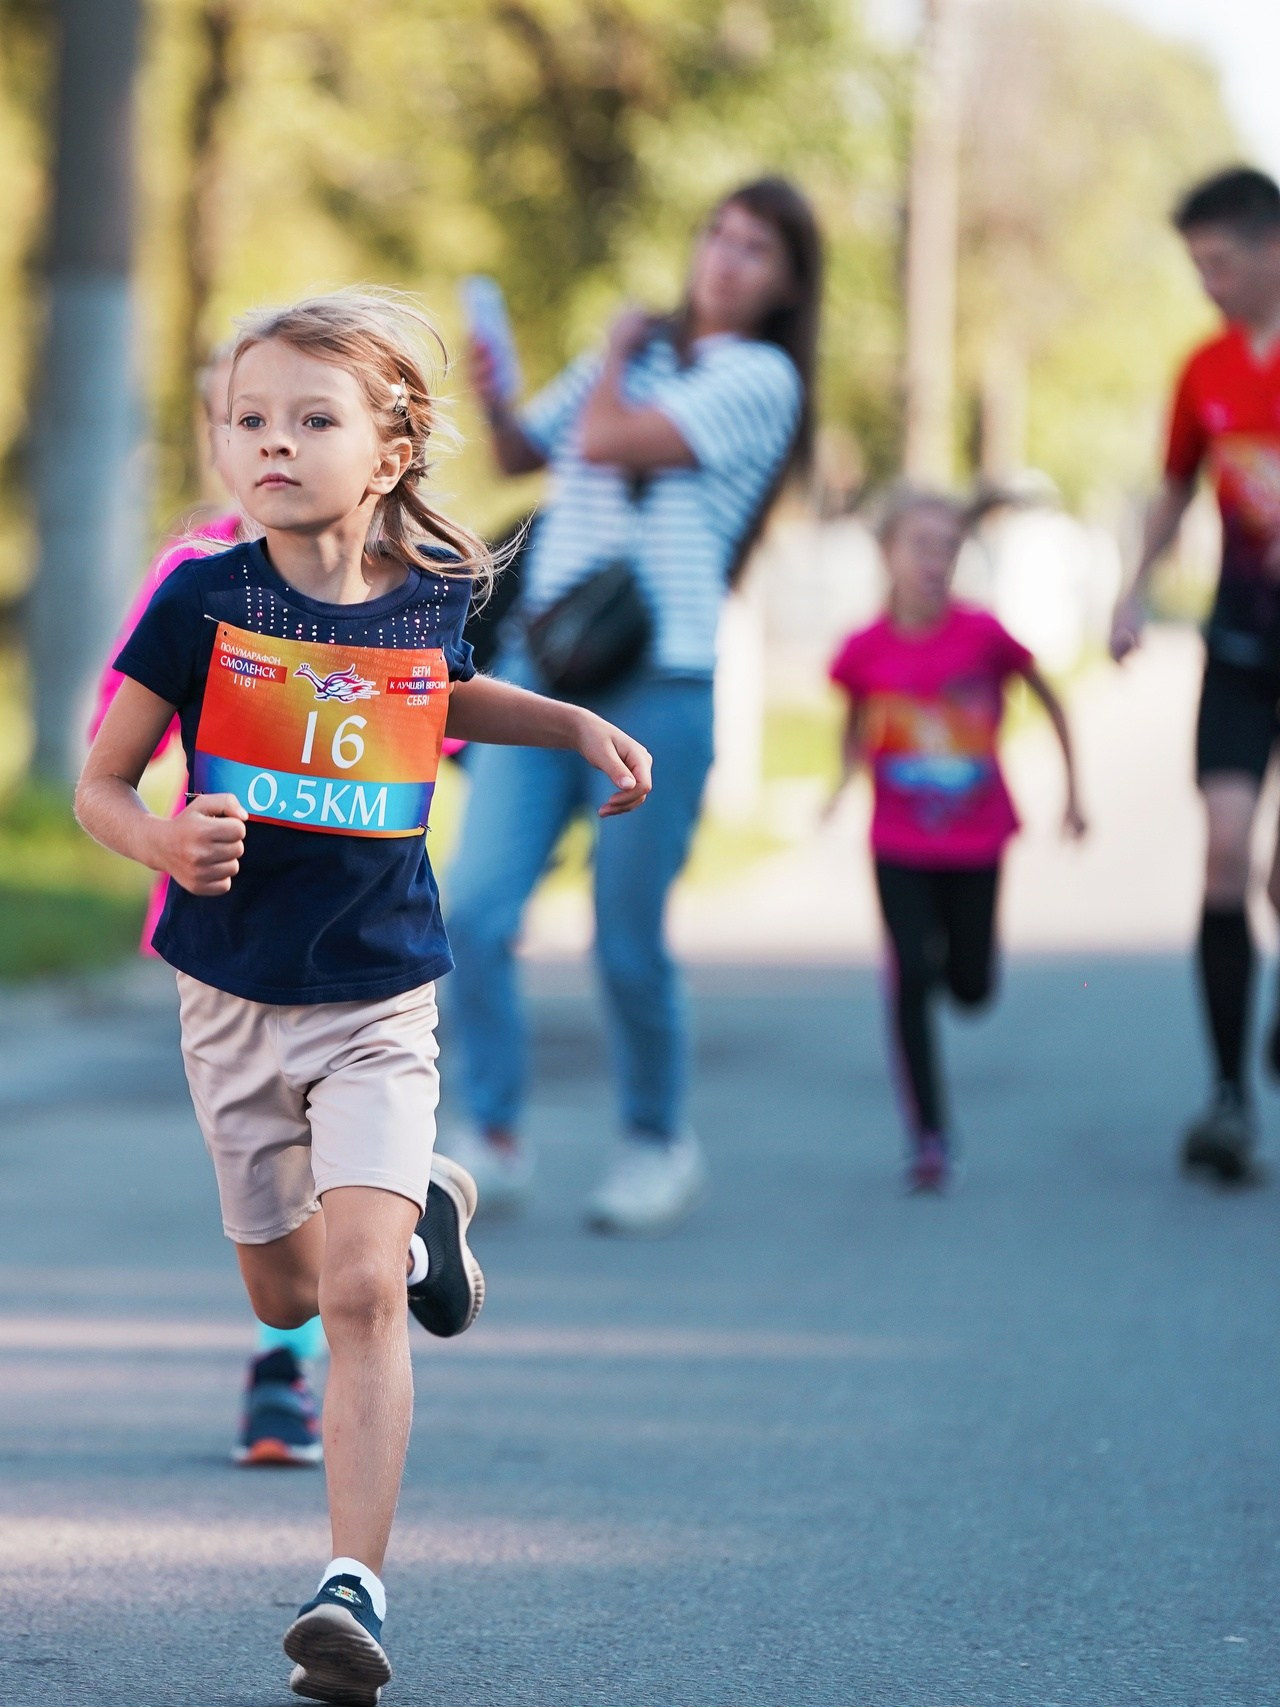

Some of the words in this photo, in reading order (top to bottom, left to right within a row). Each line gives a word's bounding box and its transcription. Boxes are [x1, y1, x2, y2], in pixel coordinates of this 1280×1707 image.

[220, 641, 281, 666] ПОЛУМАРАФОН
[220, 655, 277, 679] СМОЛЕНСК
[412, 665, 431, 677] БЕГИ
[233, 673, 256, 689] 1161
[396, 680, 425, 690] ЛУЧШЕЙ
[301, 710, 368, 770] 16
